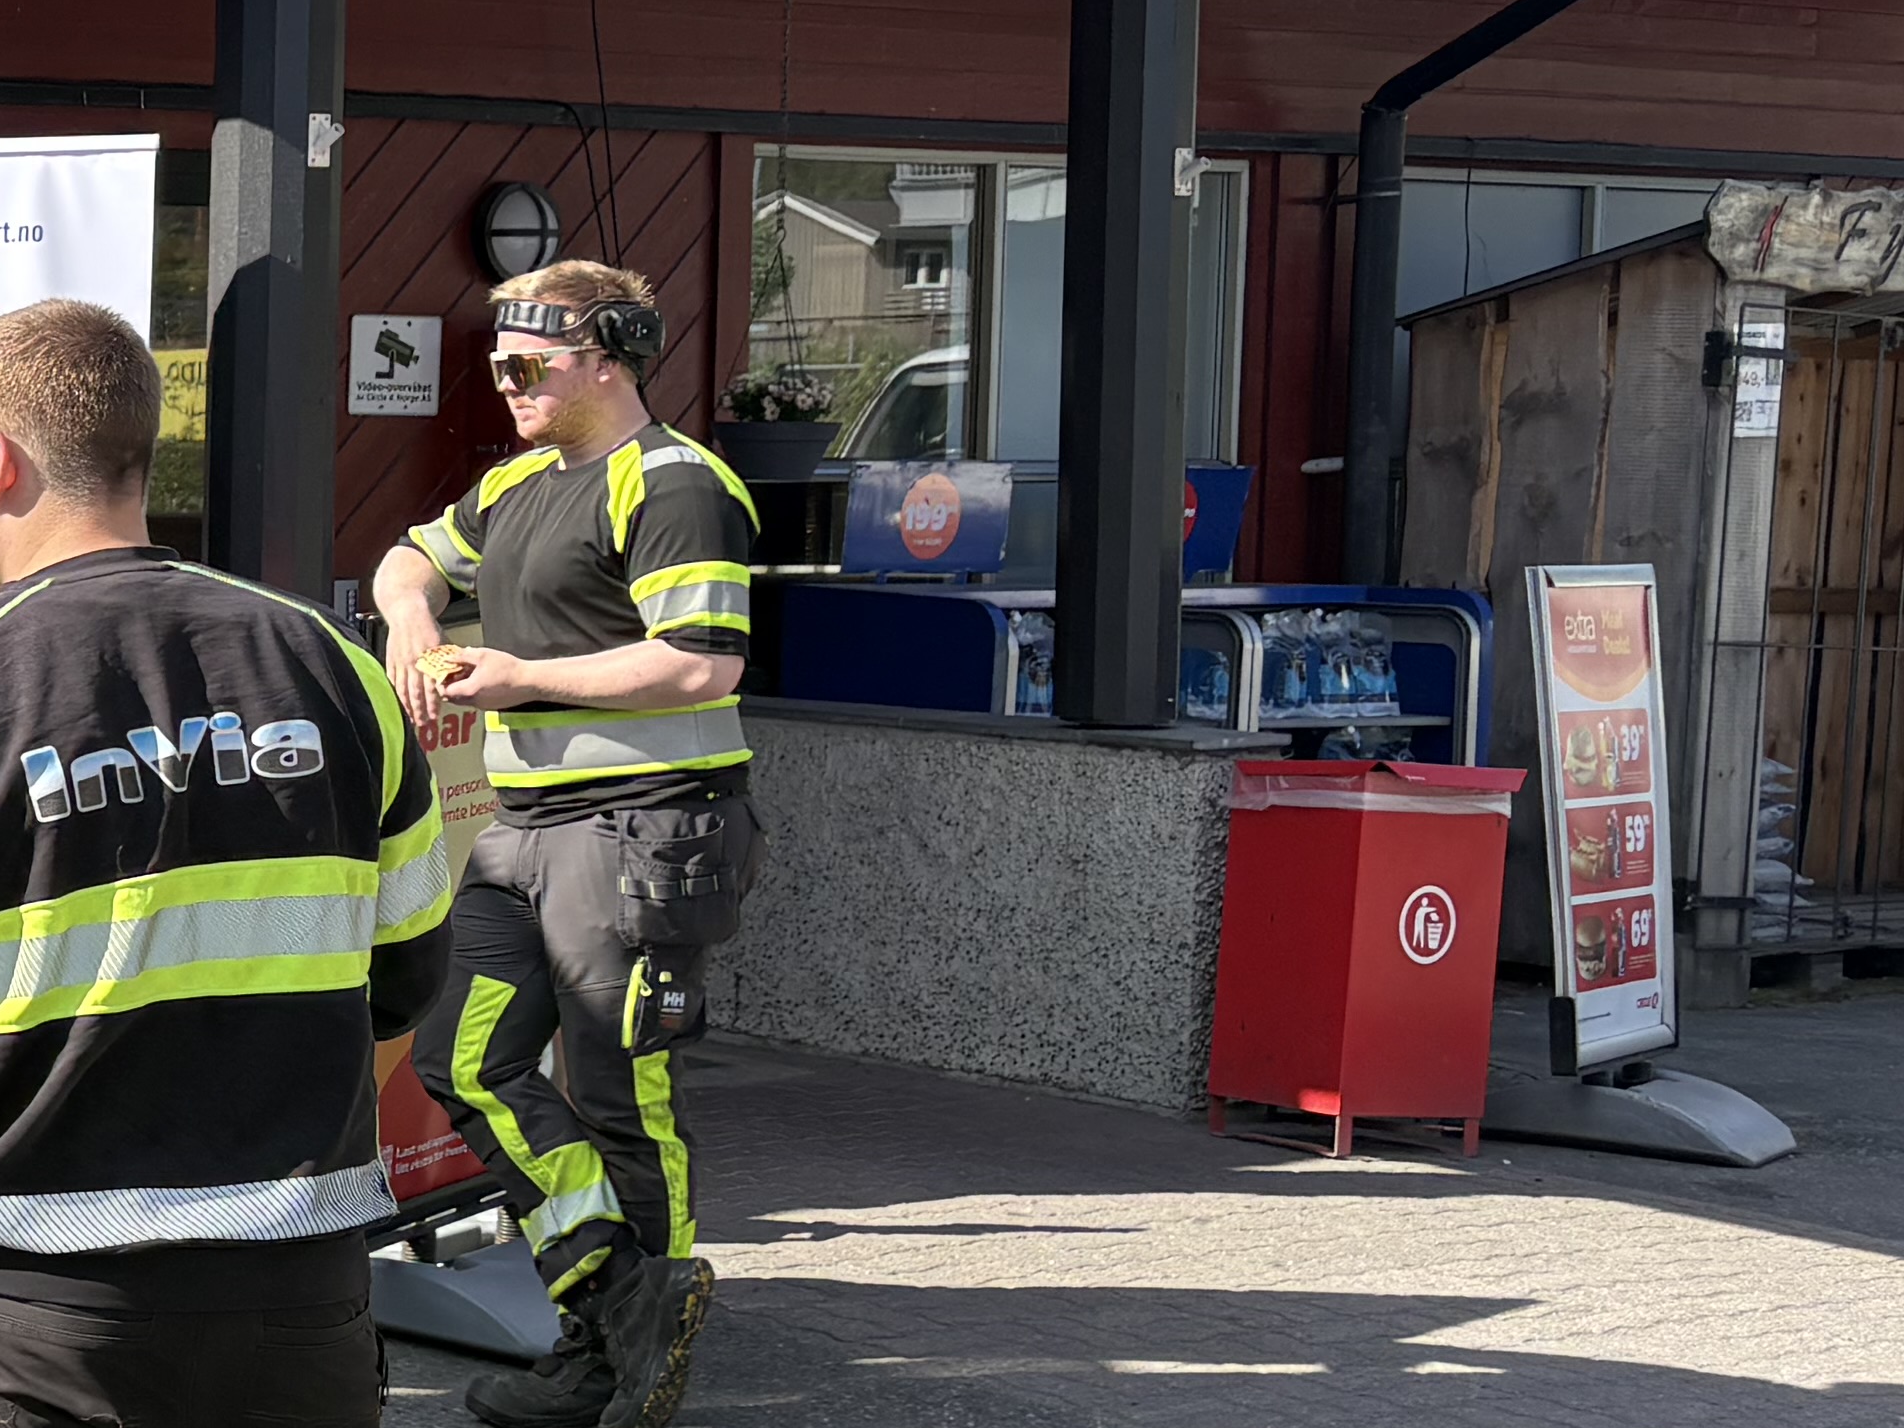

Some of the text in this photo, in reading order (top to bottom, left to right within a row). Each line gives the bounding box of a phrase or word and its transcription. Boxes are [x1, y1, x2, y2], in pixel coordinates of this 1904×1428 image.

[1620, 724, 1641, 762] 39
[20, 710, 325, 824] InVia
[1625, 814, 1647, 853] 59
